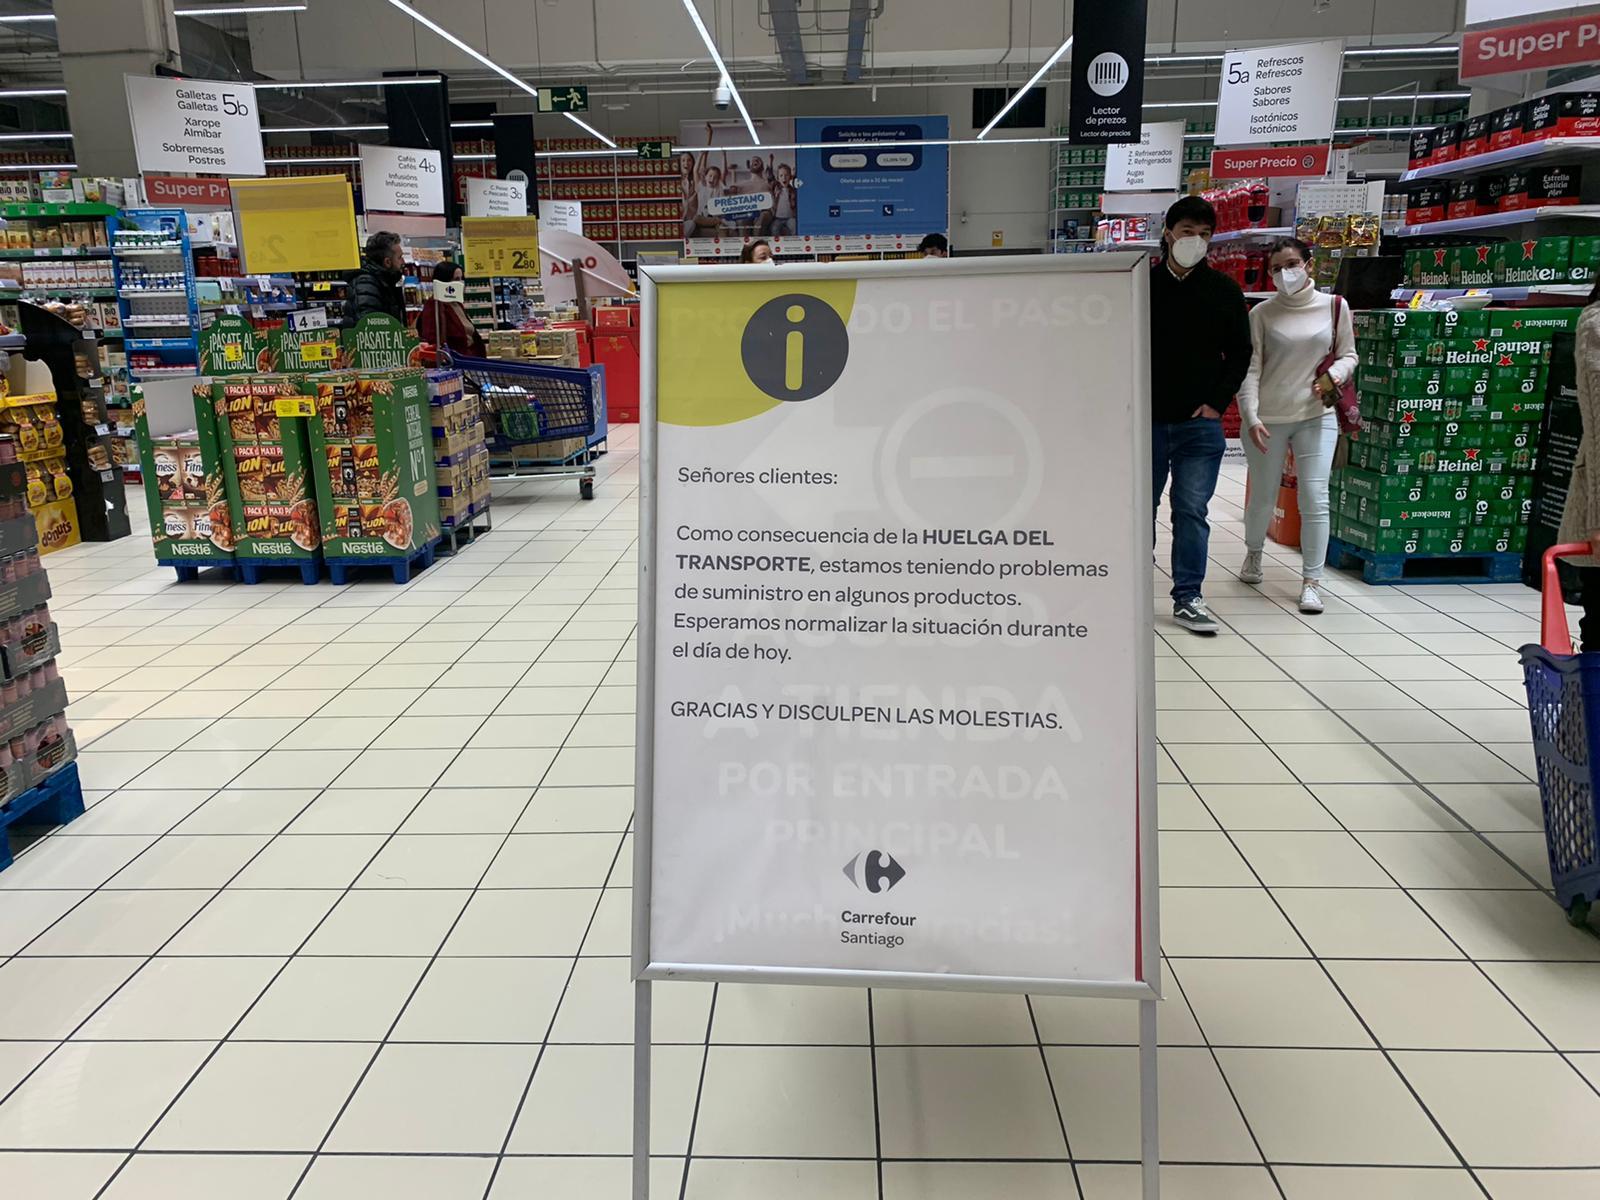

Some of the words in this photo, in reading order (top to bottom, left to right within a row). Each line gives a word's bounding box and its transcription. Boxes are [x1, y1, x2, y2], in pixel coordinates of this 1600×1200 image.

[1478, 30, 1570, 60] Super
[1257, 56, 1304, 68] Refrescos
[1227, 62, 1250, 84] 5a
[1255, 68, 1302, 79] Refrescos
[176, 90, 217, 101] Galletas
[1253, 85, 1292, 96] Sabores
[177, 101, 218, 112] Galletas
[222, 94, 248, 116] 5b
[1252, 97, 1290, 107] Sabores
[1093, 106, 1120, 115] Lector
[184, 117, 220, 129] Xarope
[1085, 116, 1097, 125] de
[1097, 117, 1127, 126] prezos
[1250, 112, 1298, 123] Isotónicos
[184, 128, 222, 138] Almíbar
[1108, 130, 1131, 138] precios
[1249, 124, 1297, 134] Isotónicos
[162, 143, 224, 155] Sobremesas
[188, 156, 226, 165] Postres
[419, 158, 436, 173] 4b
[1134, 158, 1172, 166] Refrigerados
[1224, 158, 1258, 171] Super
[1260, 155, 1297, 168] Precio
[154, 181, 205, 198] Super
[385, 180, 418, 188] Infusiones
[510, 187, 522, 199] 3b
[714, 194, 765, 207] PRÉSTAMO
[722, 204, 758, 213] CARREFOUR
[299, 316, 308, 328] 4
[1525, 319, 1568, 328] Heineken
[244, 333, 254, 350] AL
[356, 327, 390, 351] ¡PÁSATE
[394, 330, 405, 349] AL
[361, 350, 406, 369] INTEGRAL!
[229, 386, 244, 394] PACK
[252, 386, 268, 394] MAXI
[239, 447, 253, 456] PACK
[260, 447, 276, 455] MAXI
[184, 460, 202, 472] Fitn
[677, 467, 755, 484] Señores
[759, 468, 838, 485] clientes:
[1411, 511, 1451, 519] Heineken
[194, 520, 211, 531] Fitn
[41, 520, 72, 548] donuts
[676, 525, 733, 542] Como
[737, 527, 869, 544] consecuencia
[873, 528, 898, 544] de
[902, 528, 918, 544] la
[922, 529, 1008, 545] HUELGA
[1013, 530, 1054, 546] DEL
[171, 543, 211, 555] Nestlé
[252, 543, 291, 554] Nestlé
[342, 542, 384, 554] Nestlé
[675, 554, 815, 574] TRANSPORTE,
[819, 558, 902, 574] estamos
[907, 558, 995, 576] teniendo
[999, 560, 1109, 579] problemas
[674, 583, 698, 599] de
[702, 584, 803, 601] suministro
[807, 589, 831, 602] en
[835, 587, 910, 607] algunos
[914, 588, 1022, 608] productos.
[674, 613, 780, 632] Esperamos
[785, 616, 887, 633] normalizar
[892, 617, 907, 633] la
[911, 617, 1002, 635] situación
[1007, 619, 1088, 638] durante
[672, 642, 688, 658] el
[693, 642, 721, 659] día
[725, 643, 749, 660] de
[754, 644, 792, 664] hoy.
[671, 701, 758, 719] GRACIAS
[762, 703, 774, 719] Y
[778, 704, 891, 723] DISCULPEN
[896, 707, 934, 724] LAS
[939, 709, 1063, 729] MOLESTIAS.
[841, 910, 917, 926] Carrefour
[840, 931, 904, 949] Santiago
